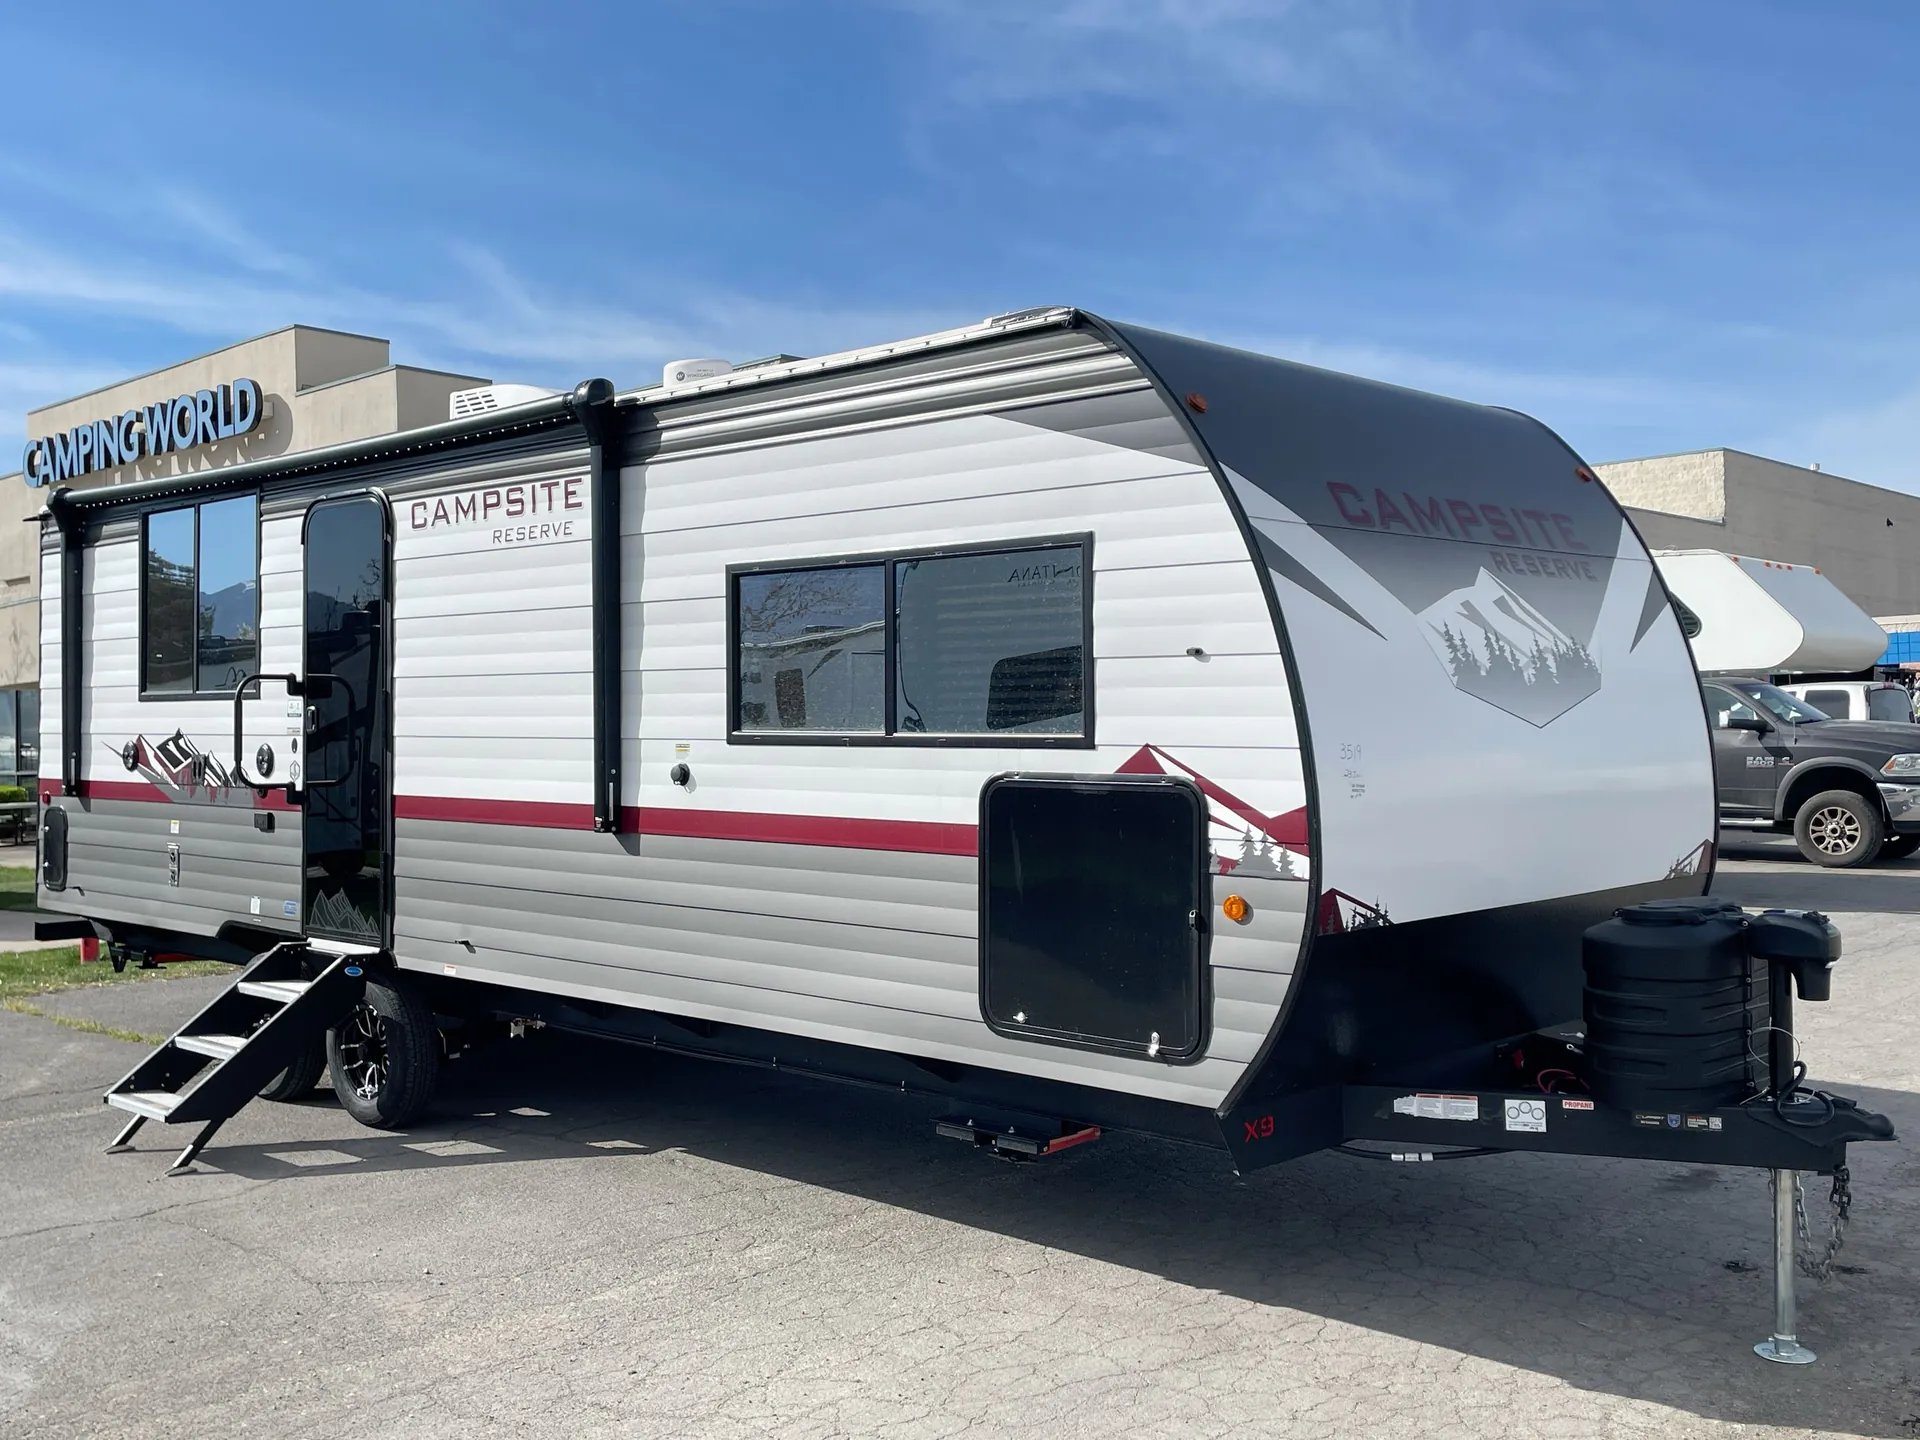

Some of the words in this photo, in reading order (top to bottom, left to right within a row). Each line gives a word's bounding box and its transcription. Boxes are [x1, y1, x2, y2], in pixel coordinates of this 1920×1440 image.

[23, 410, 144, 488] CAMPING
[143, 378, 263, 456] WORLD
[411, 477, 584, 530] CAMPSITE
[1326, 481, 1593, 552] CAMPSITE
[492, 521, 574, 545] RESERVE
[1488, 551, 1600, 582] RESERVE
[1564, 1101, 1593, 1109] PROPANE
